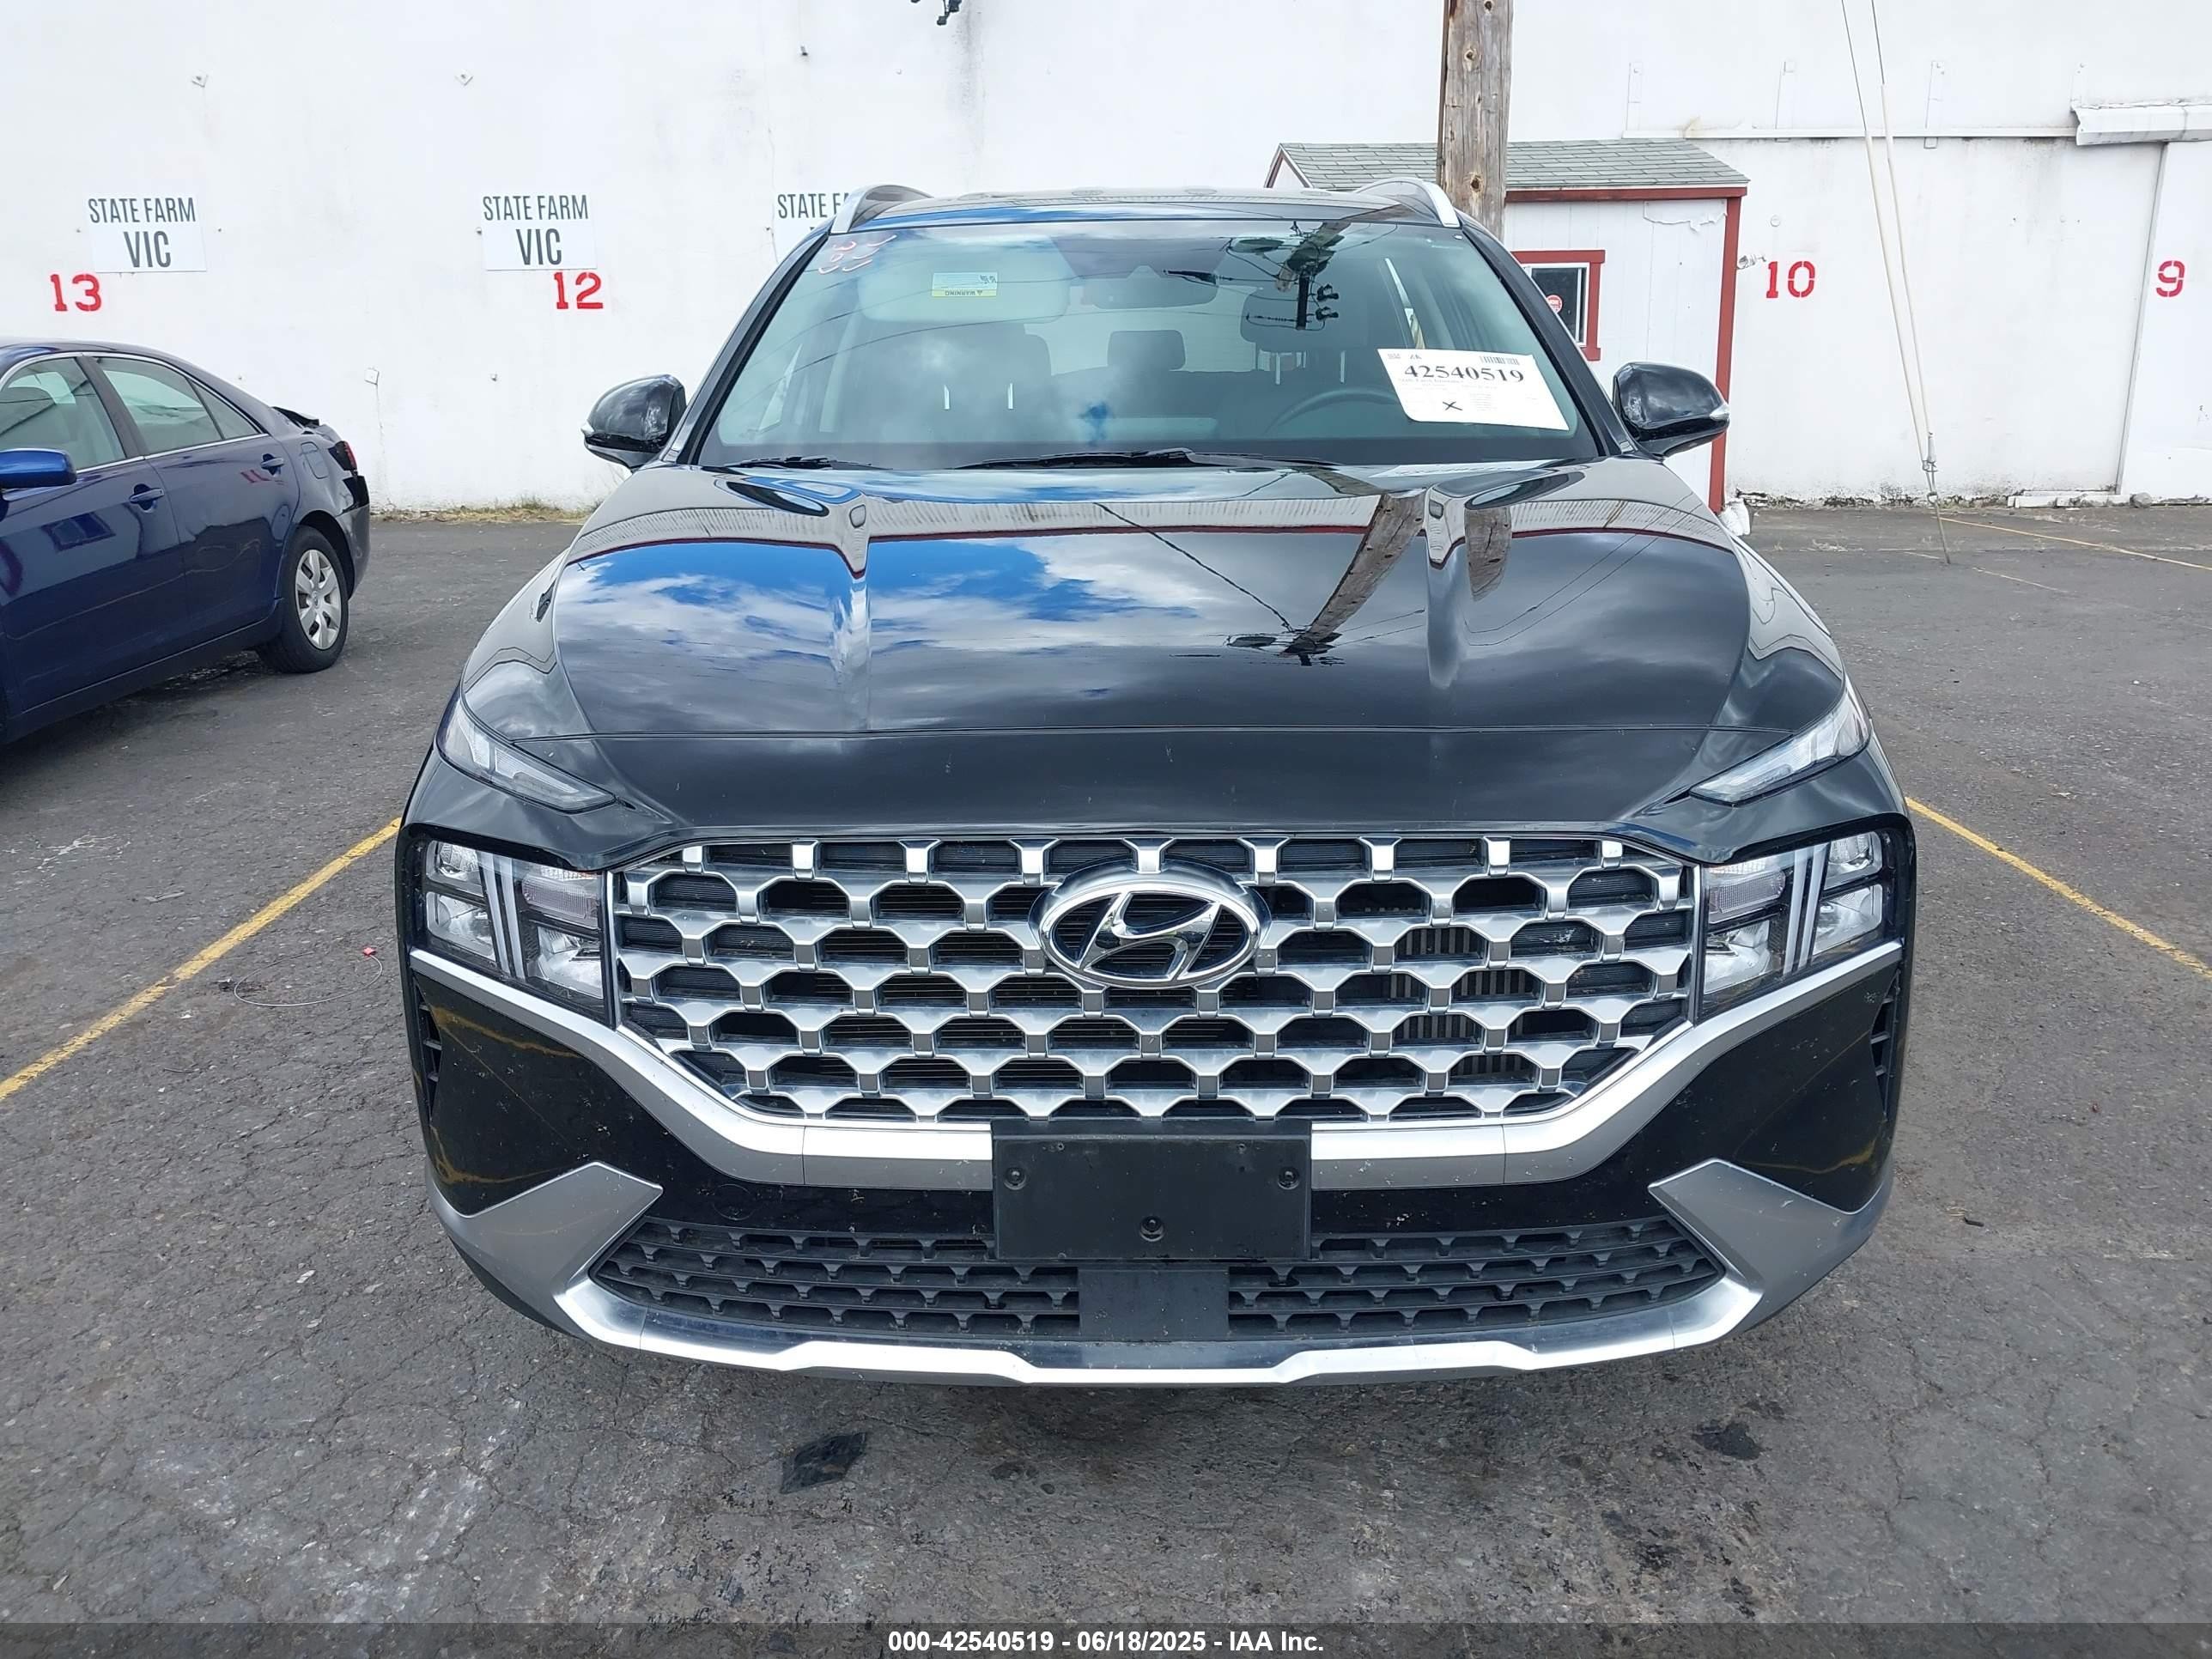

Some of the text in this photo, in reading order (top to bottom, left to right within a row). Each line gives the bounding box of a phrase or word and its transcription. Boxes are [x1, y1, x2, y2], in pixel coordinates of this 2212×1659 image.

[88, 197, 197, 223] STATE FARM
[483, 194, 589, 222] STATE FARM
[777, 193, 828, 219] STATE
[123, 230, 172, 268] VIC
[515, 228, 562, 265] VIC
[50, 273, 102, 312] 13
[553, 271, 605, 310] 12
[1765, 260, 1815, 299] 10
[2155, 259, 2186, 297] 9
[1404, 364, 1524, 383] 42540519
